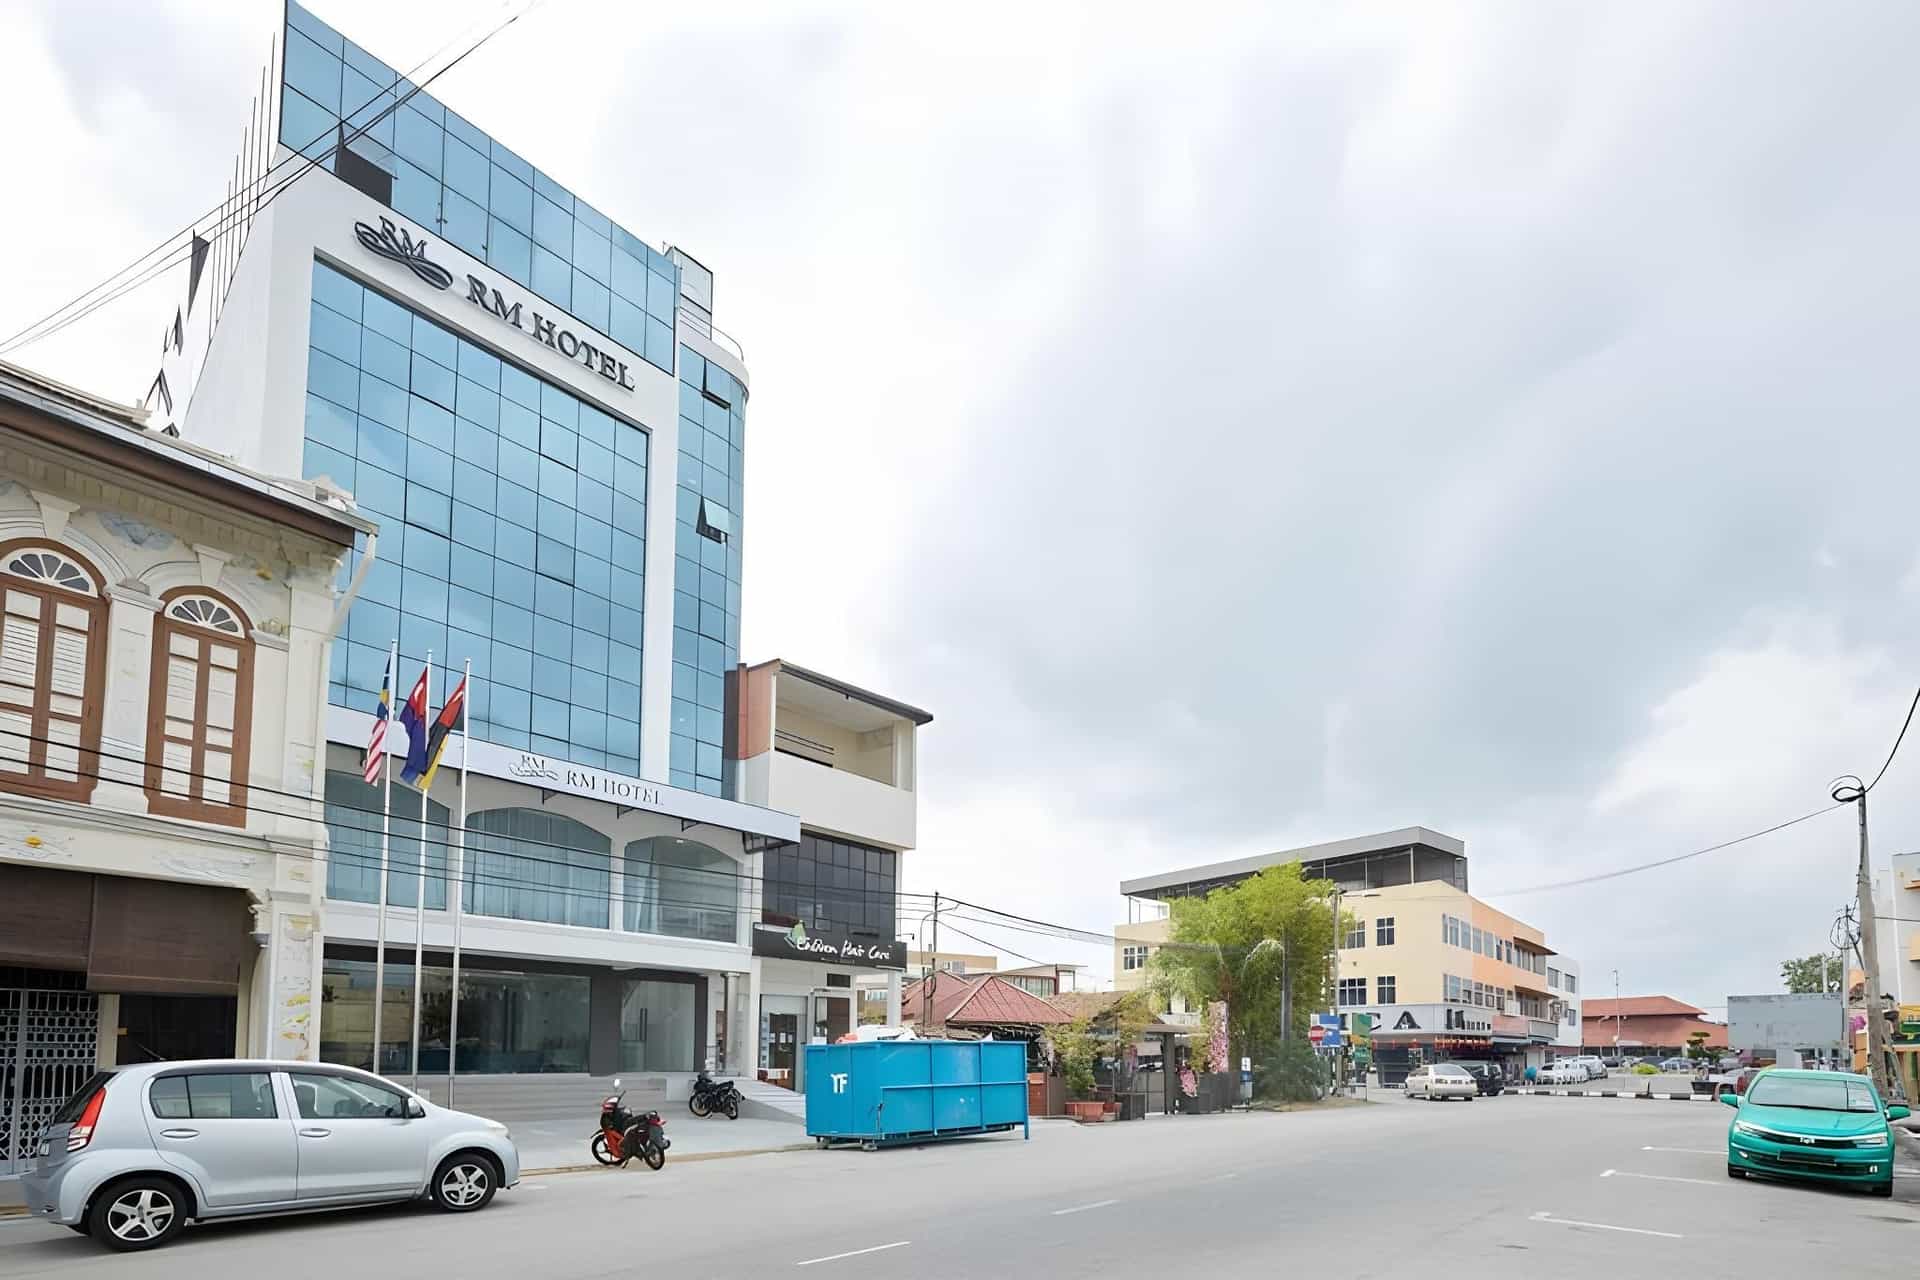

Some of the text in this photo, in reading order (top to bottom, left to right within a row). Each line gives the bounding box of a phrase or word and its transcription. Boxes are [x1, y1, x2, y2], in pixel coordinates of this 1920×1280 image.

[465, 274, 635, 392] RM HOTEL
[567, 769, 664, 806] RM HOTEL
[830, 1073, 849, 1094] TF
